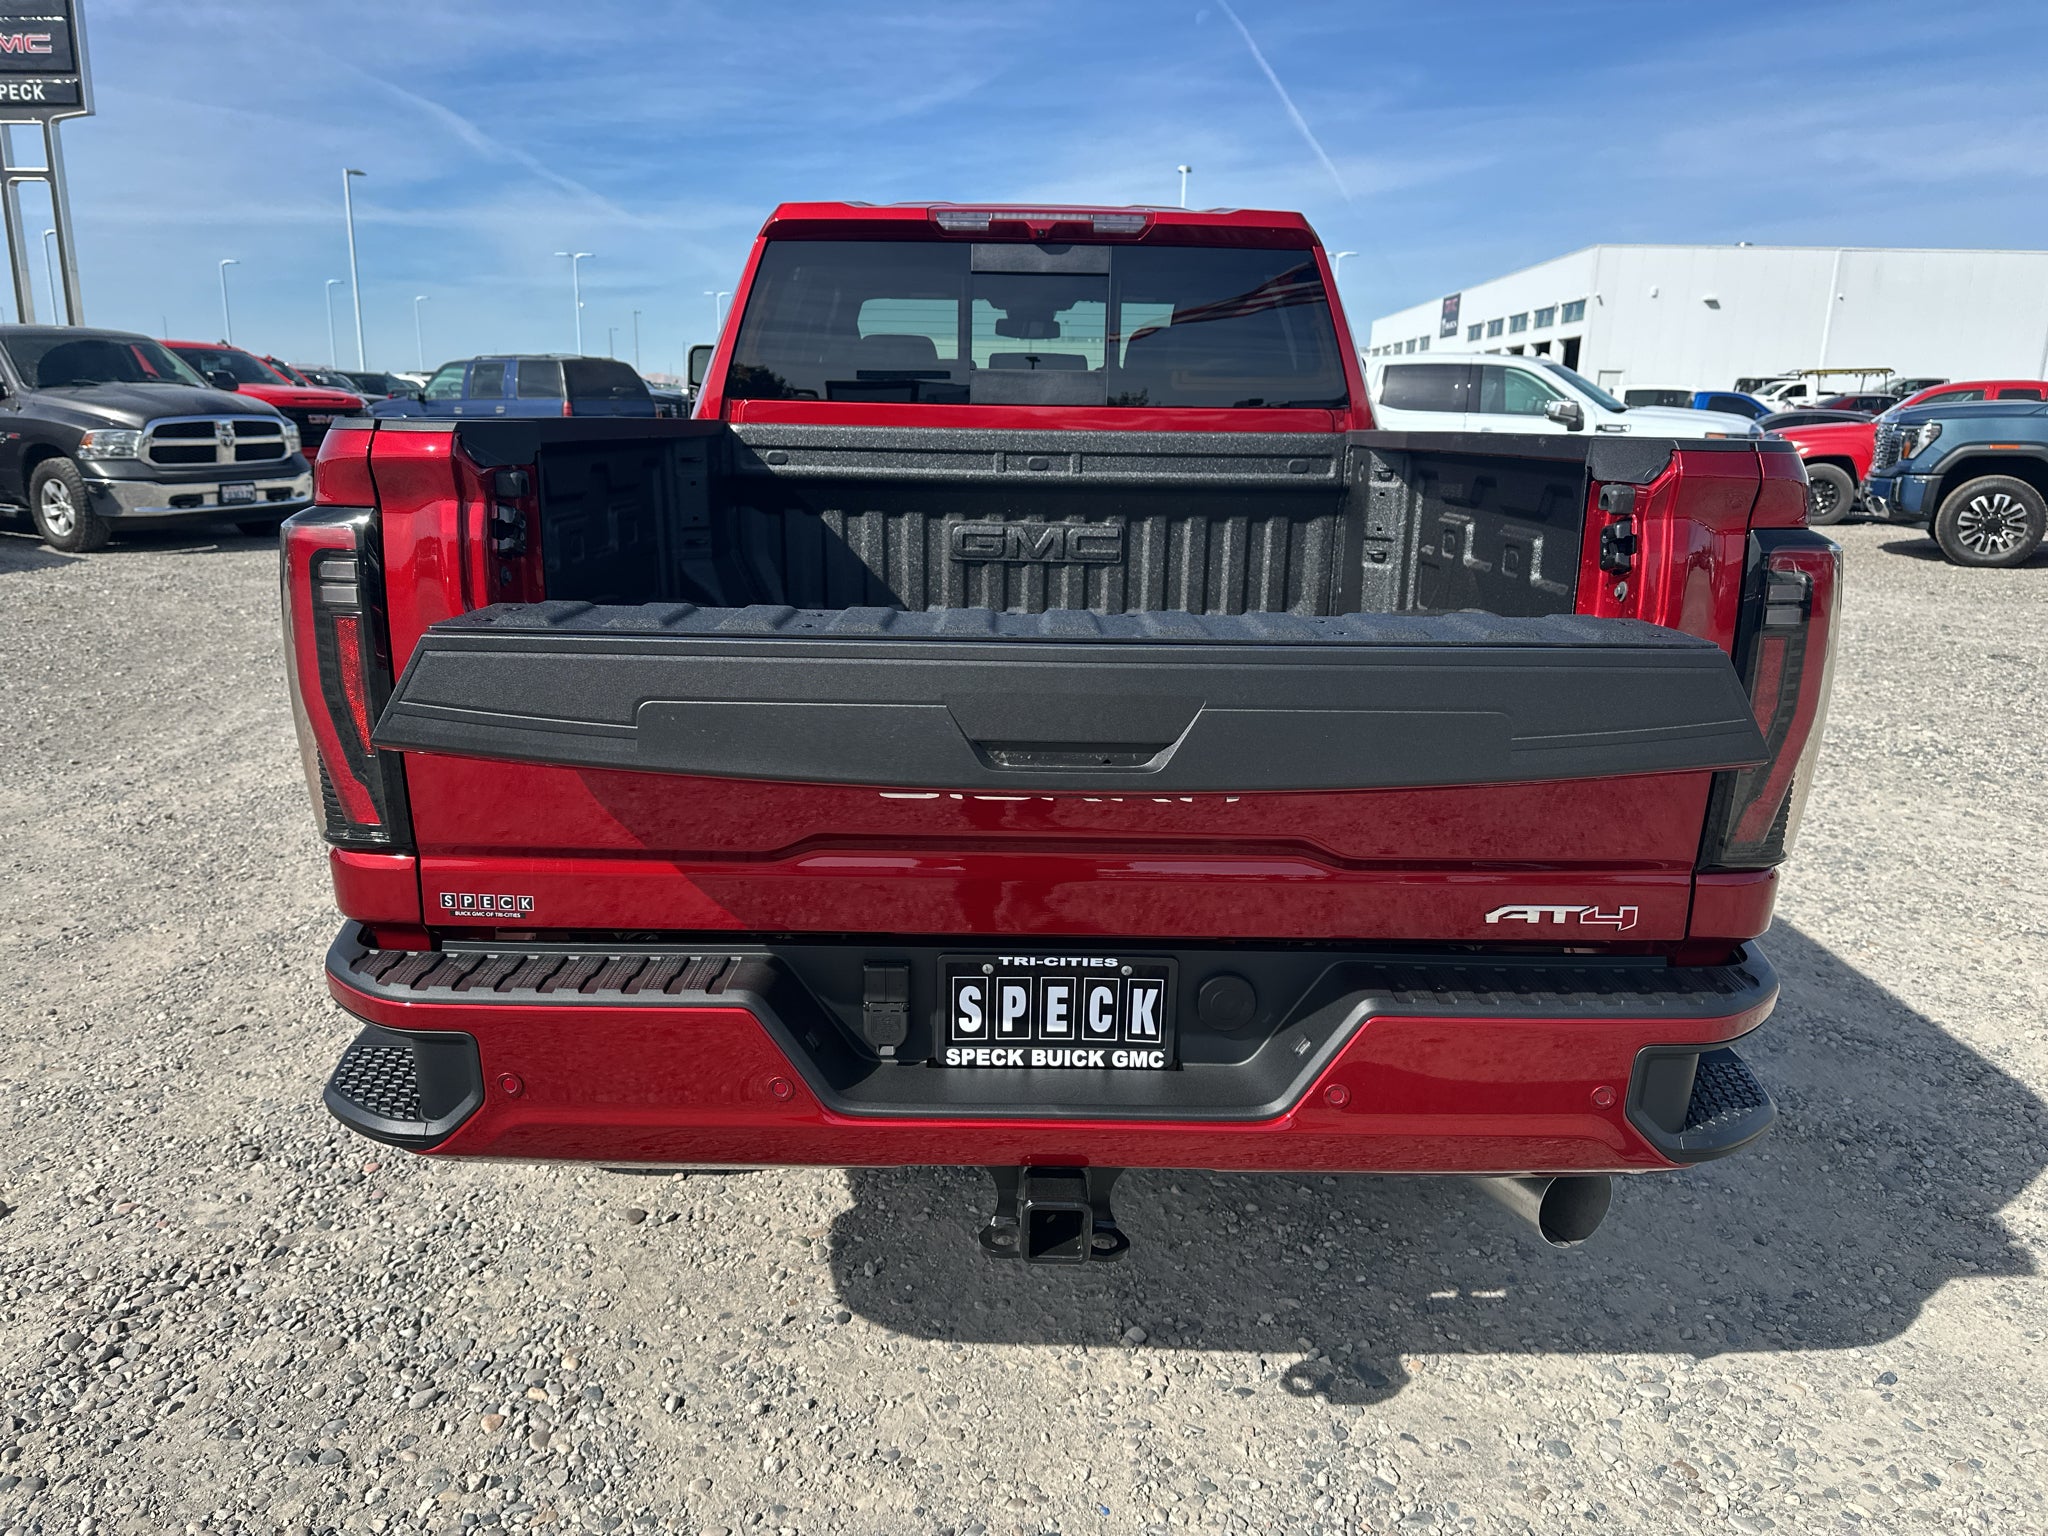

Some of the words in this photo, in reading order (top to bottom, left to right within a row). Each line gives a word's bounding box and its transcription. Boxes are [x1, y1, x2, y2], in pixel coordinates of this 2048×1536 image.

[951, 525, 1120, 560] GMC
[444, 895, 531, 910] SPECK
[1485, 904, 1639, 932] AT4
[998, 956, 1119, 968] TRI-CITIES
[957, 985, 1160, 1036] SPECK
[946, 1048, 1024, 1066] SPECK
[1031, 1049, 1105, 1067] BUICK
[1111, 1050, 1165, 1069] GMC
